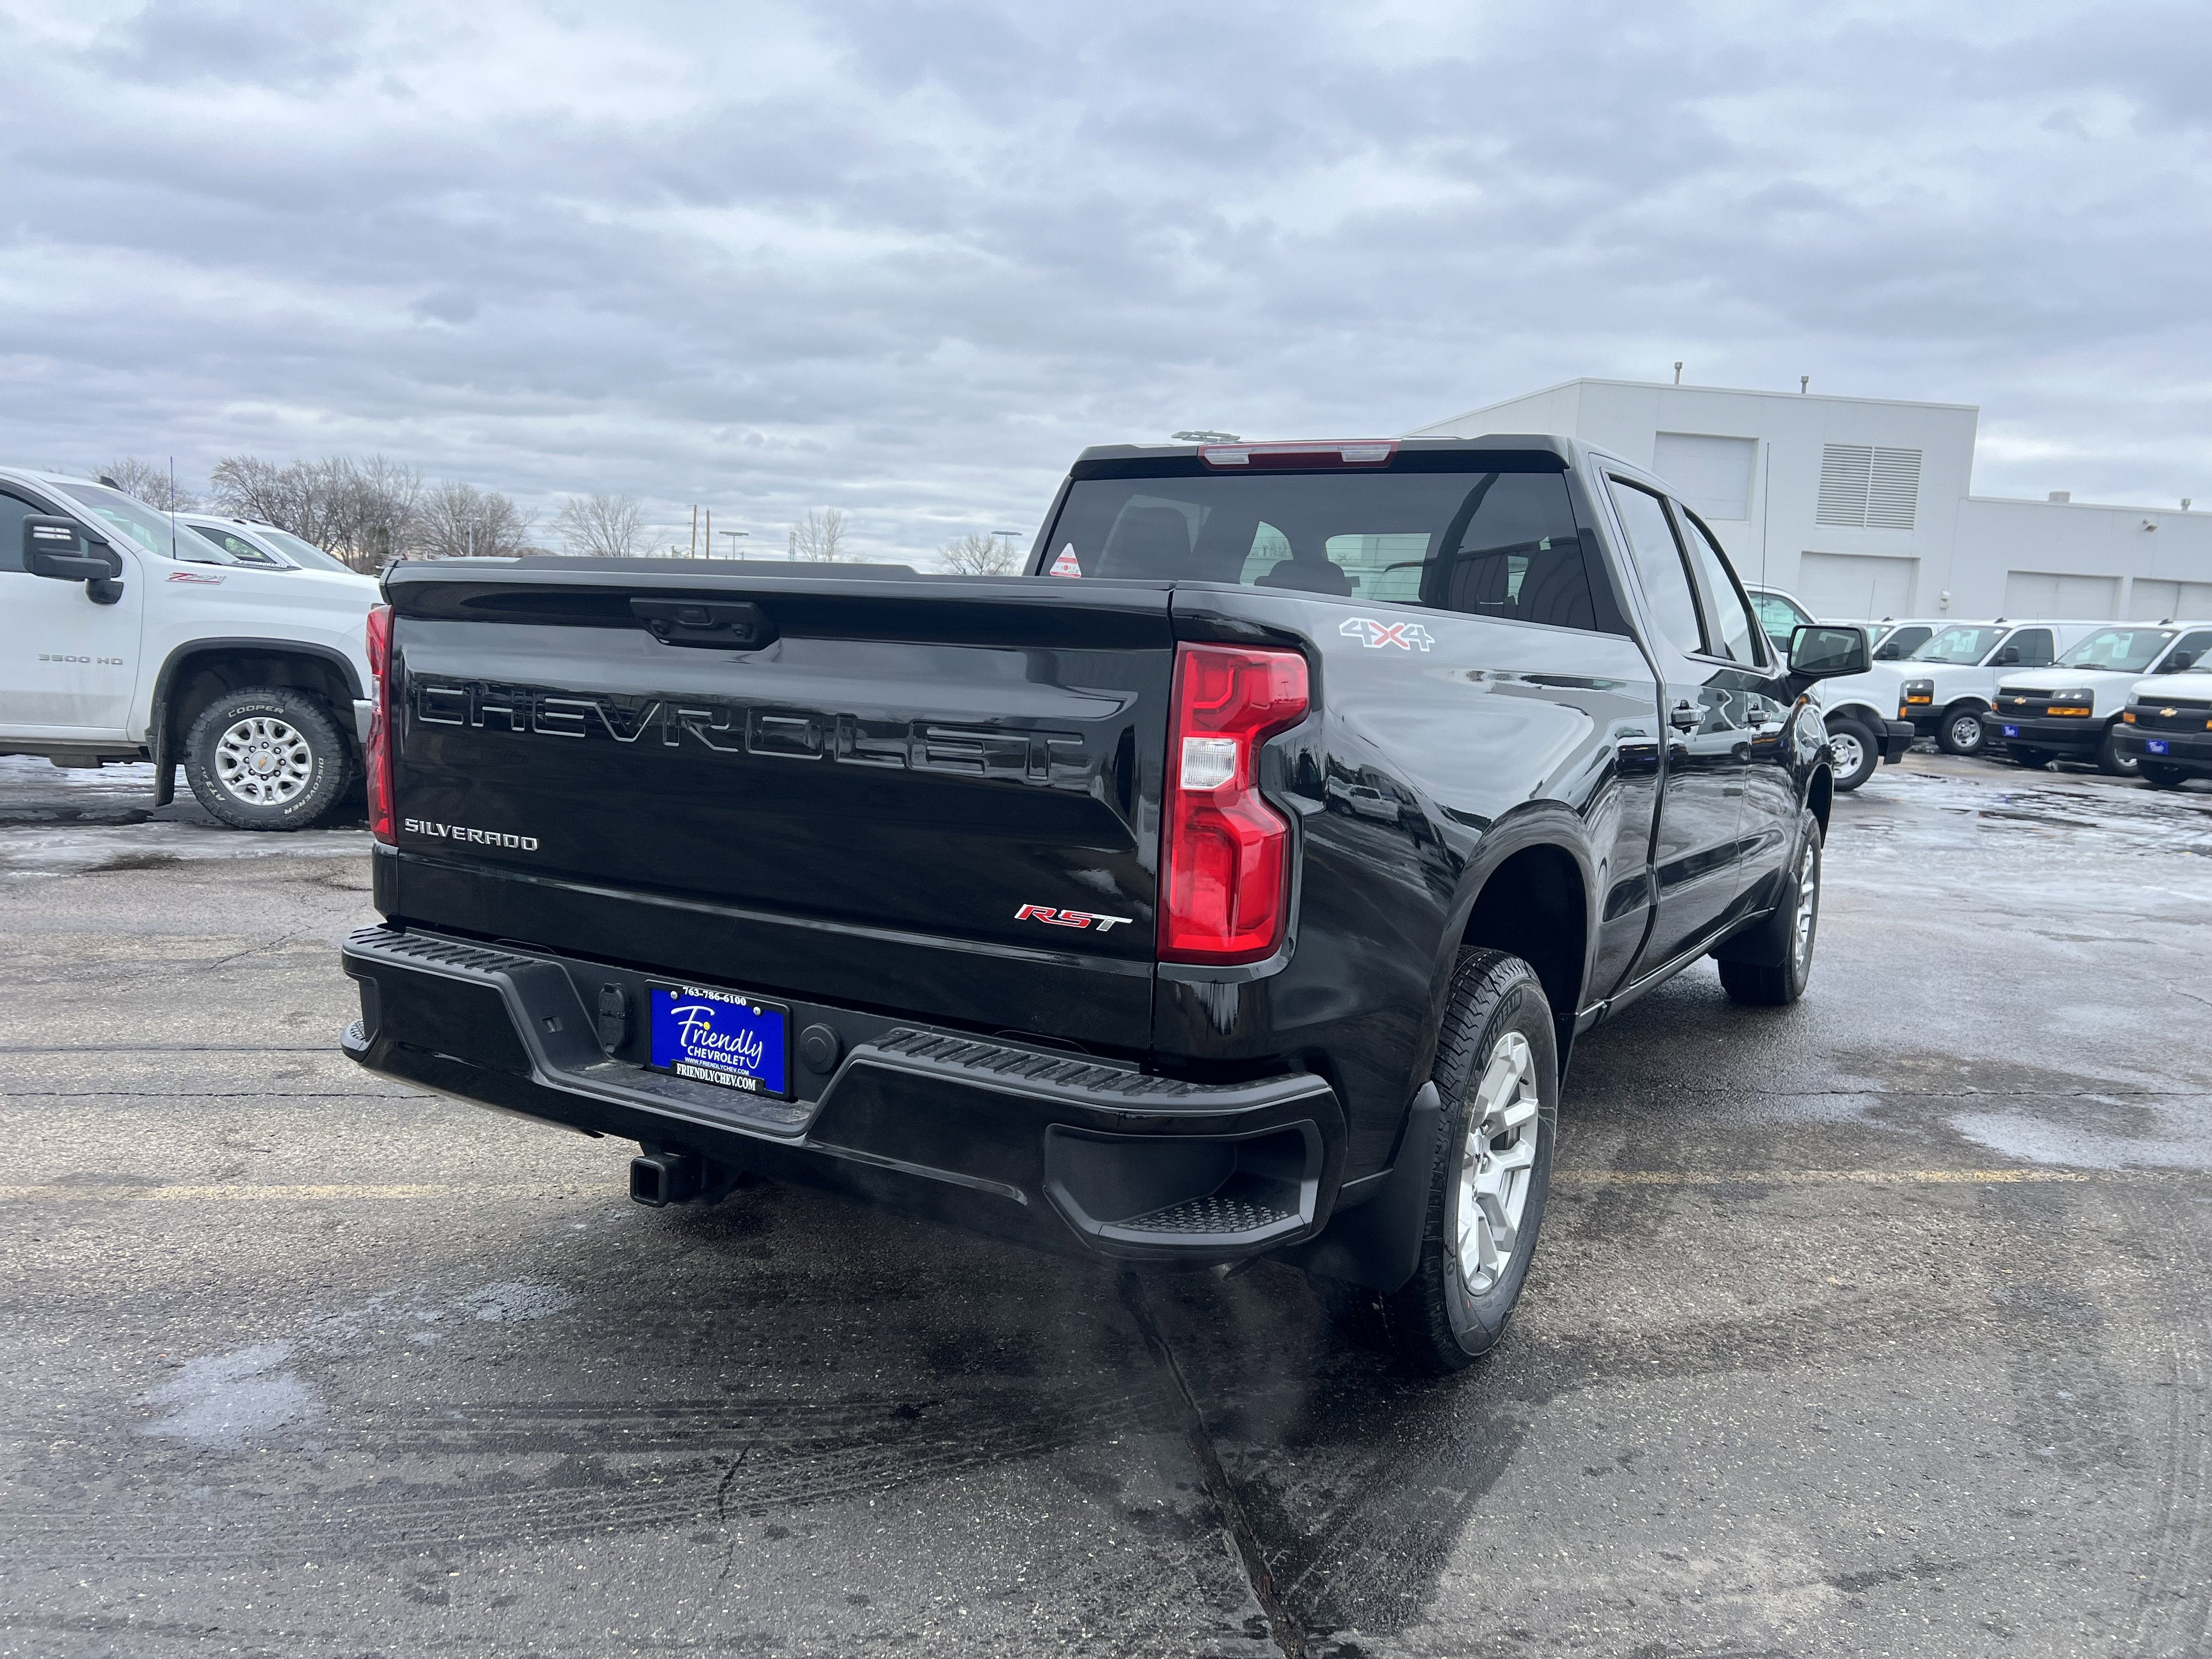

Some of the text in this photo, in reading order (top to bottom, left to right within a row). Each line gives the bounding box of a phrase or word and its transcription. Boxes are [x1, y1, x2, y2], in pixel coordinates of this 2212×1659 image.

[165, 572, 226, 585] Z71
[38, 654, 90, 663] 3500
[228, 704, 284, 718] COOPER
[417, 680, 1085, 781] CHEVROLET
[284, 757, 324, 815] DISCOVERER
[404, 818, 540, 851] SILVERADO
[1014, 904, 1133, 932] RST
[682, 986, 747, 1006] 763-786-6100
[670, 1005, 763, 1069] Friendly
[684, 1057, 749, 1076] WWW.FRIENDLYCHEV.COM
[687, 1045, 745, 1066] CHEVROLET
[676, 1063, 756, 1091] FRIENDLYCHEV.COM
